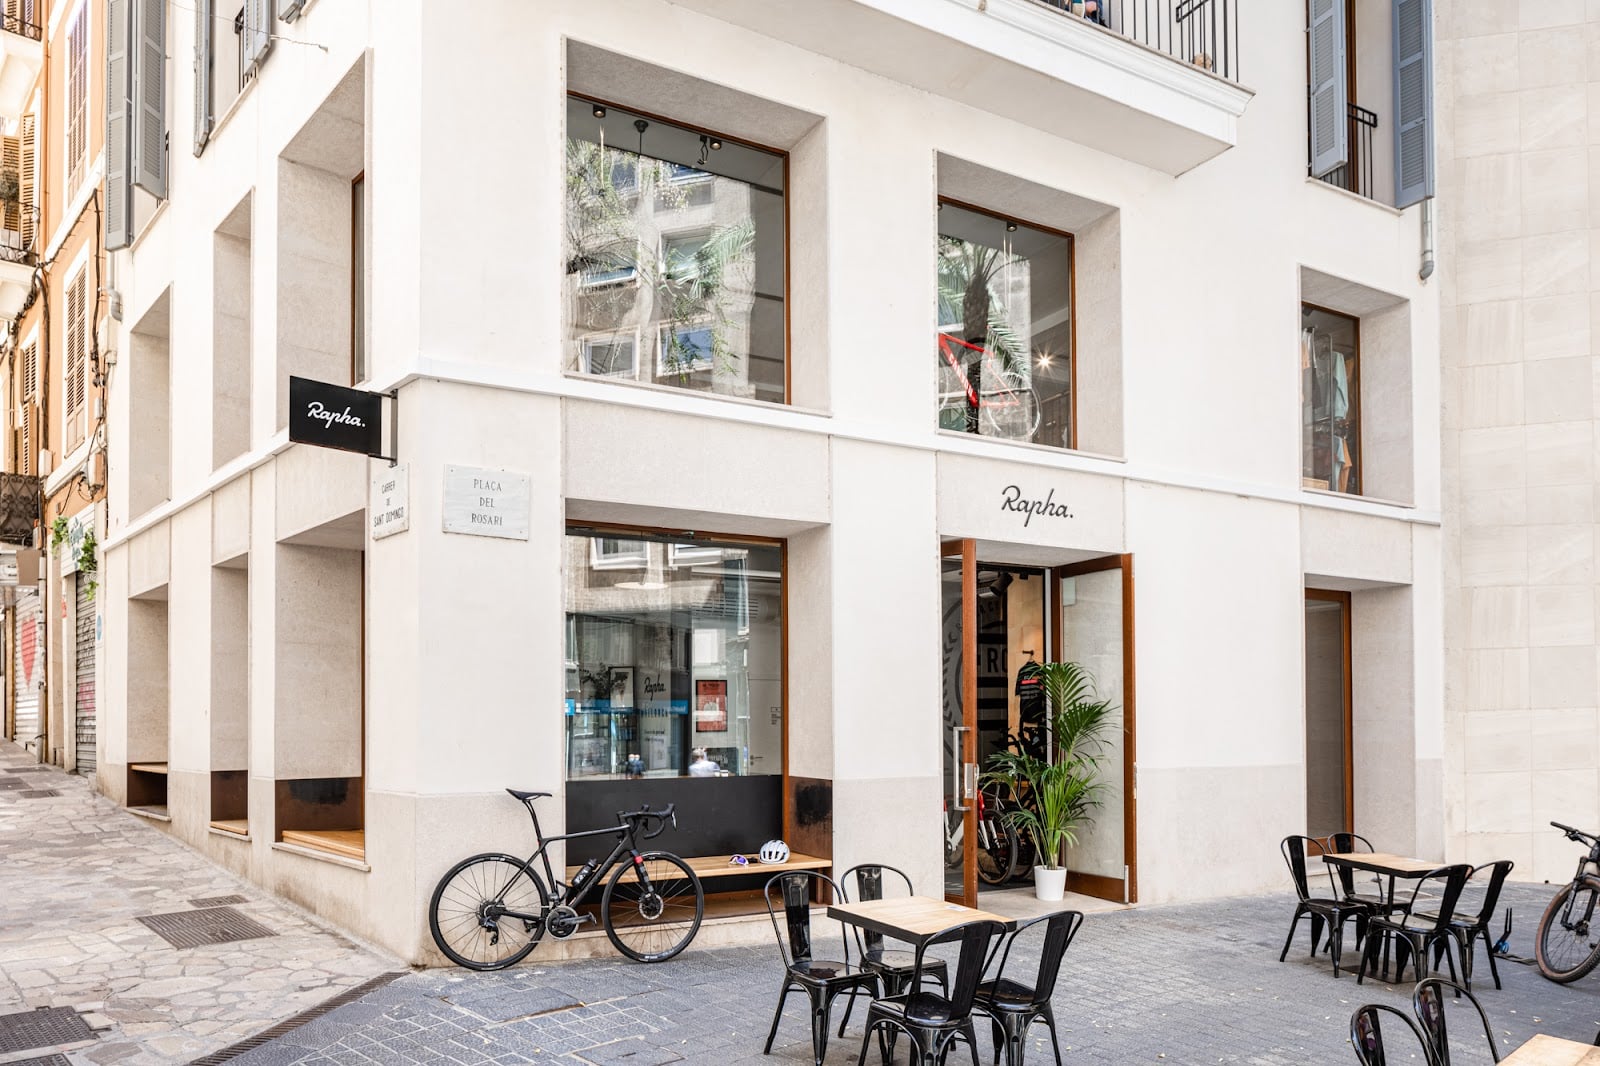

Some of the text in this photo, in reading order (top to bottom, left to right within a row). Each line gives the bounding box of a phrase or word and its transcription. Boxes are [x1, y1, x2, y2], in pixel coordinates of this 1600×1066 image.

[307, 401, 366, 429] Rapha.
[382, 480, 395, 494] CARRER
[479, 496, 495, 508] DEL
[1001, 485, 1074, 527] Rapha.
[374, 513, 385, 528] SANT
[471, 512, 503, 526] ROSARI
